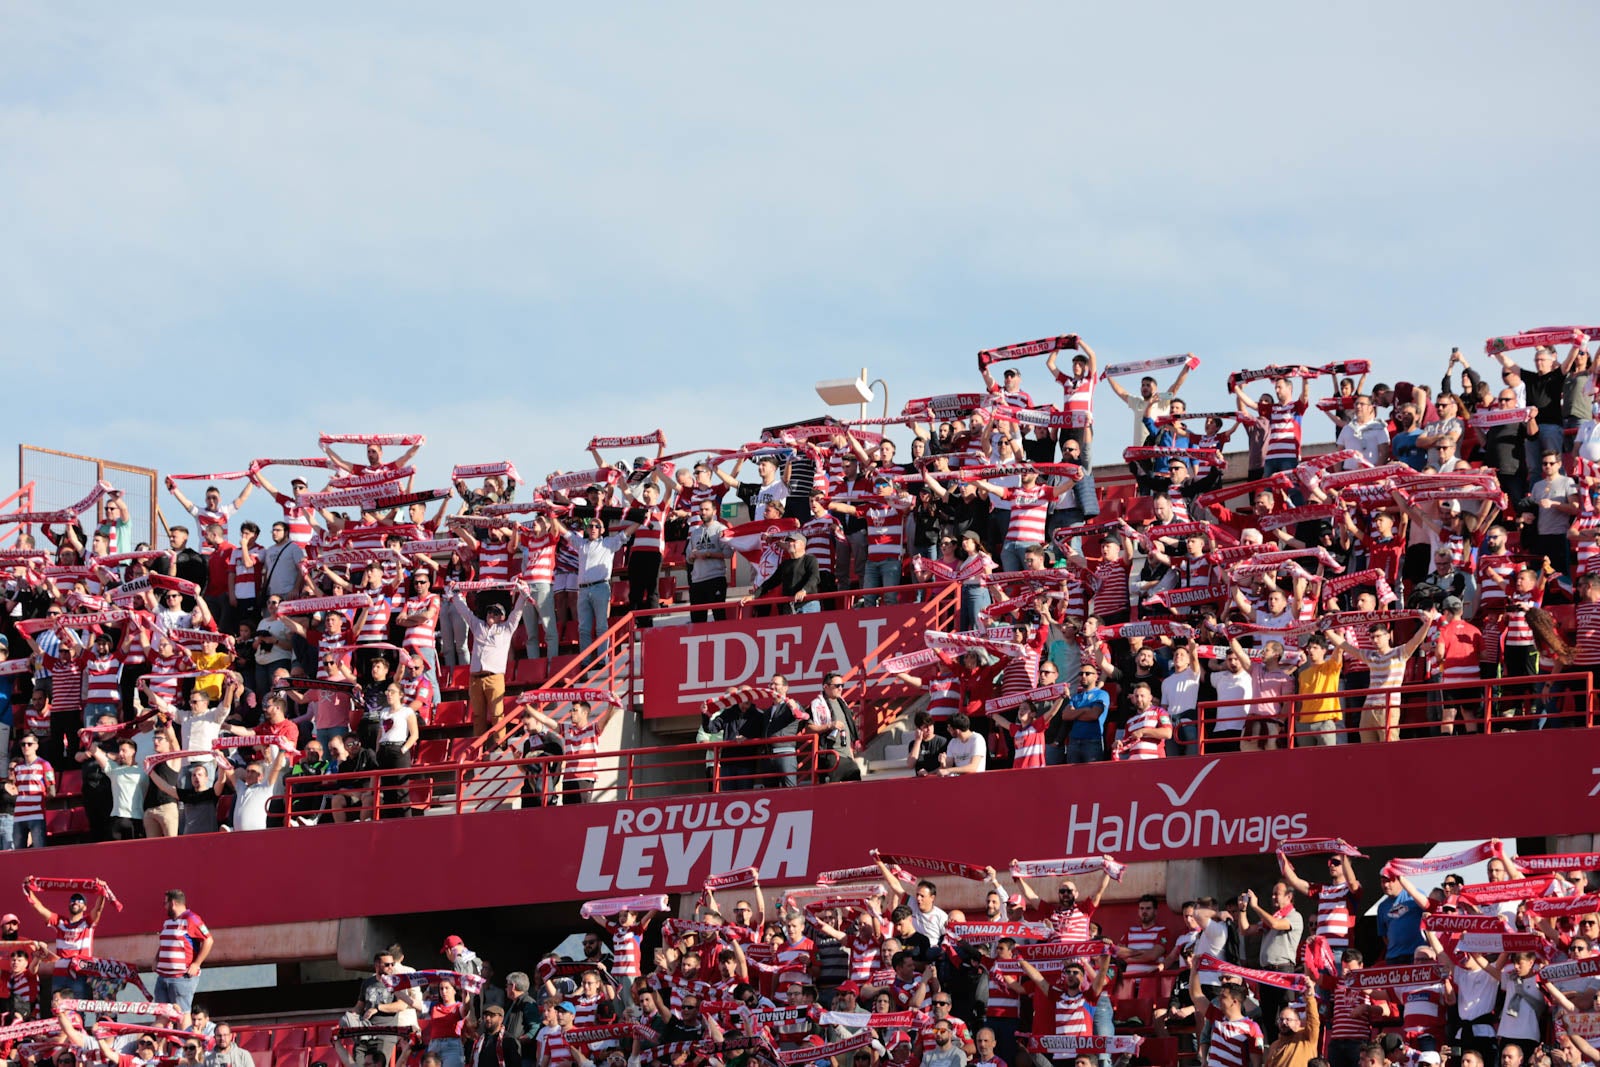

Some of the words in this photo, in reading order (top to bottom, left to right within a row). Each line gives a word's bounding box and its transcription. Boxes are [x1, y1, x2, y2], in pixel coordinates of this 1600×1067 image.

[1170, 592, 1211, 605] GRANADA
[679, 618, 904, 691] IDEAL
[538, 691, 581, 701] GRANADA
[221, 735, 261, 747] GRANADA
[613, 798, 770, 834] ROTULOS
[576, 810, 813, 892] LEYVA
[1530, 856, 1582, 869] GRANADA
[1584, 855, 1599, 866] CF
[1533, 897, 1567, 912] Eterna
[1566, 893, 1598, 910] Lucha
[1427, 915, 1478, 929] GRANADA
[1480, 918, 1498, 929] C.F.
[955, 924, 1003, 936] GRANADA
[1005, 924, 1026, 935] C.F.
[1027, 944, 1074, 957] GRANADA
[1076, 943, 1095, 953] C.F.
[79, 963, 127, 976] GRANADA
[1540, 959, 1598, 980] GRANADA
[78, 1001, 137, 1013] GRANADA
[565, 1030, 610, 1044] GRANADA
[1040, 1036, 1094, 1049] GRANADA
